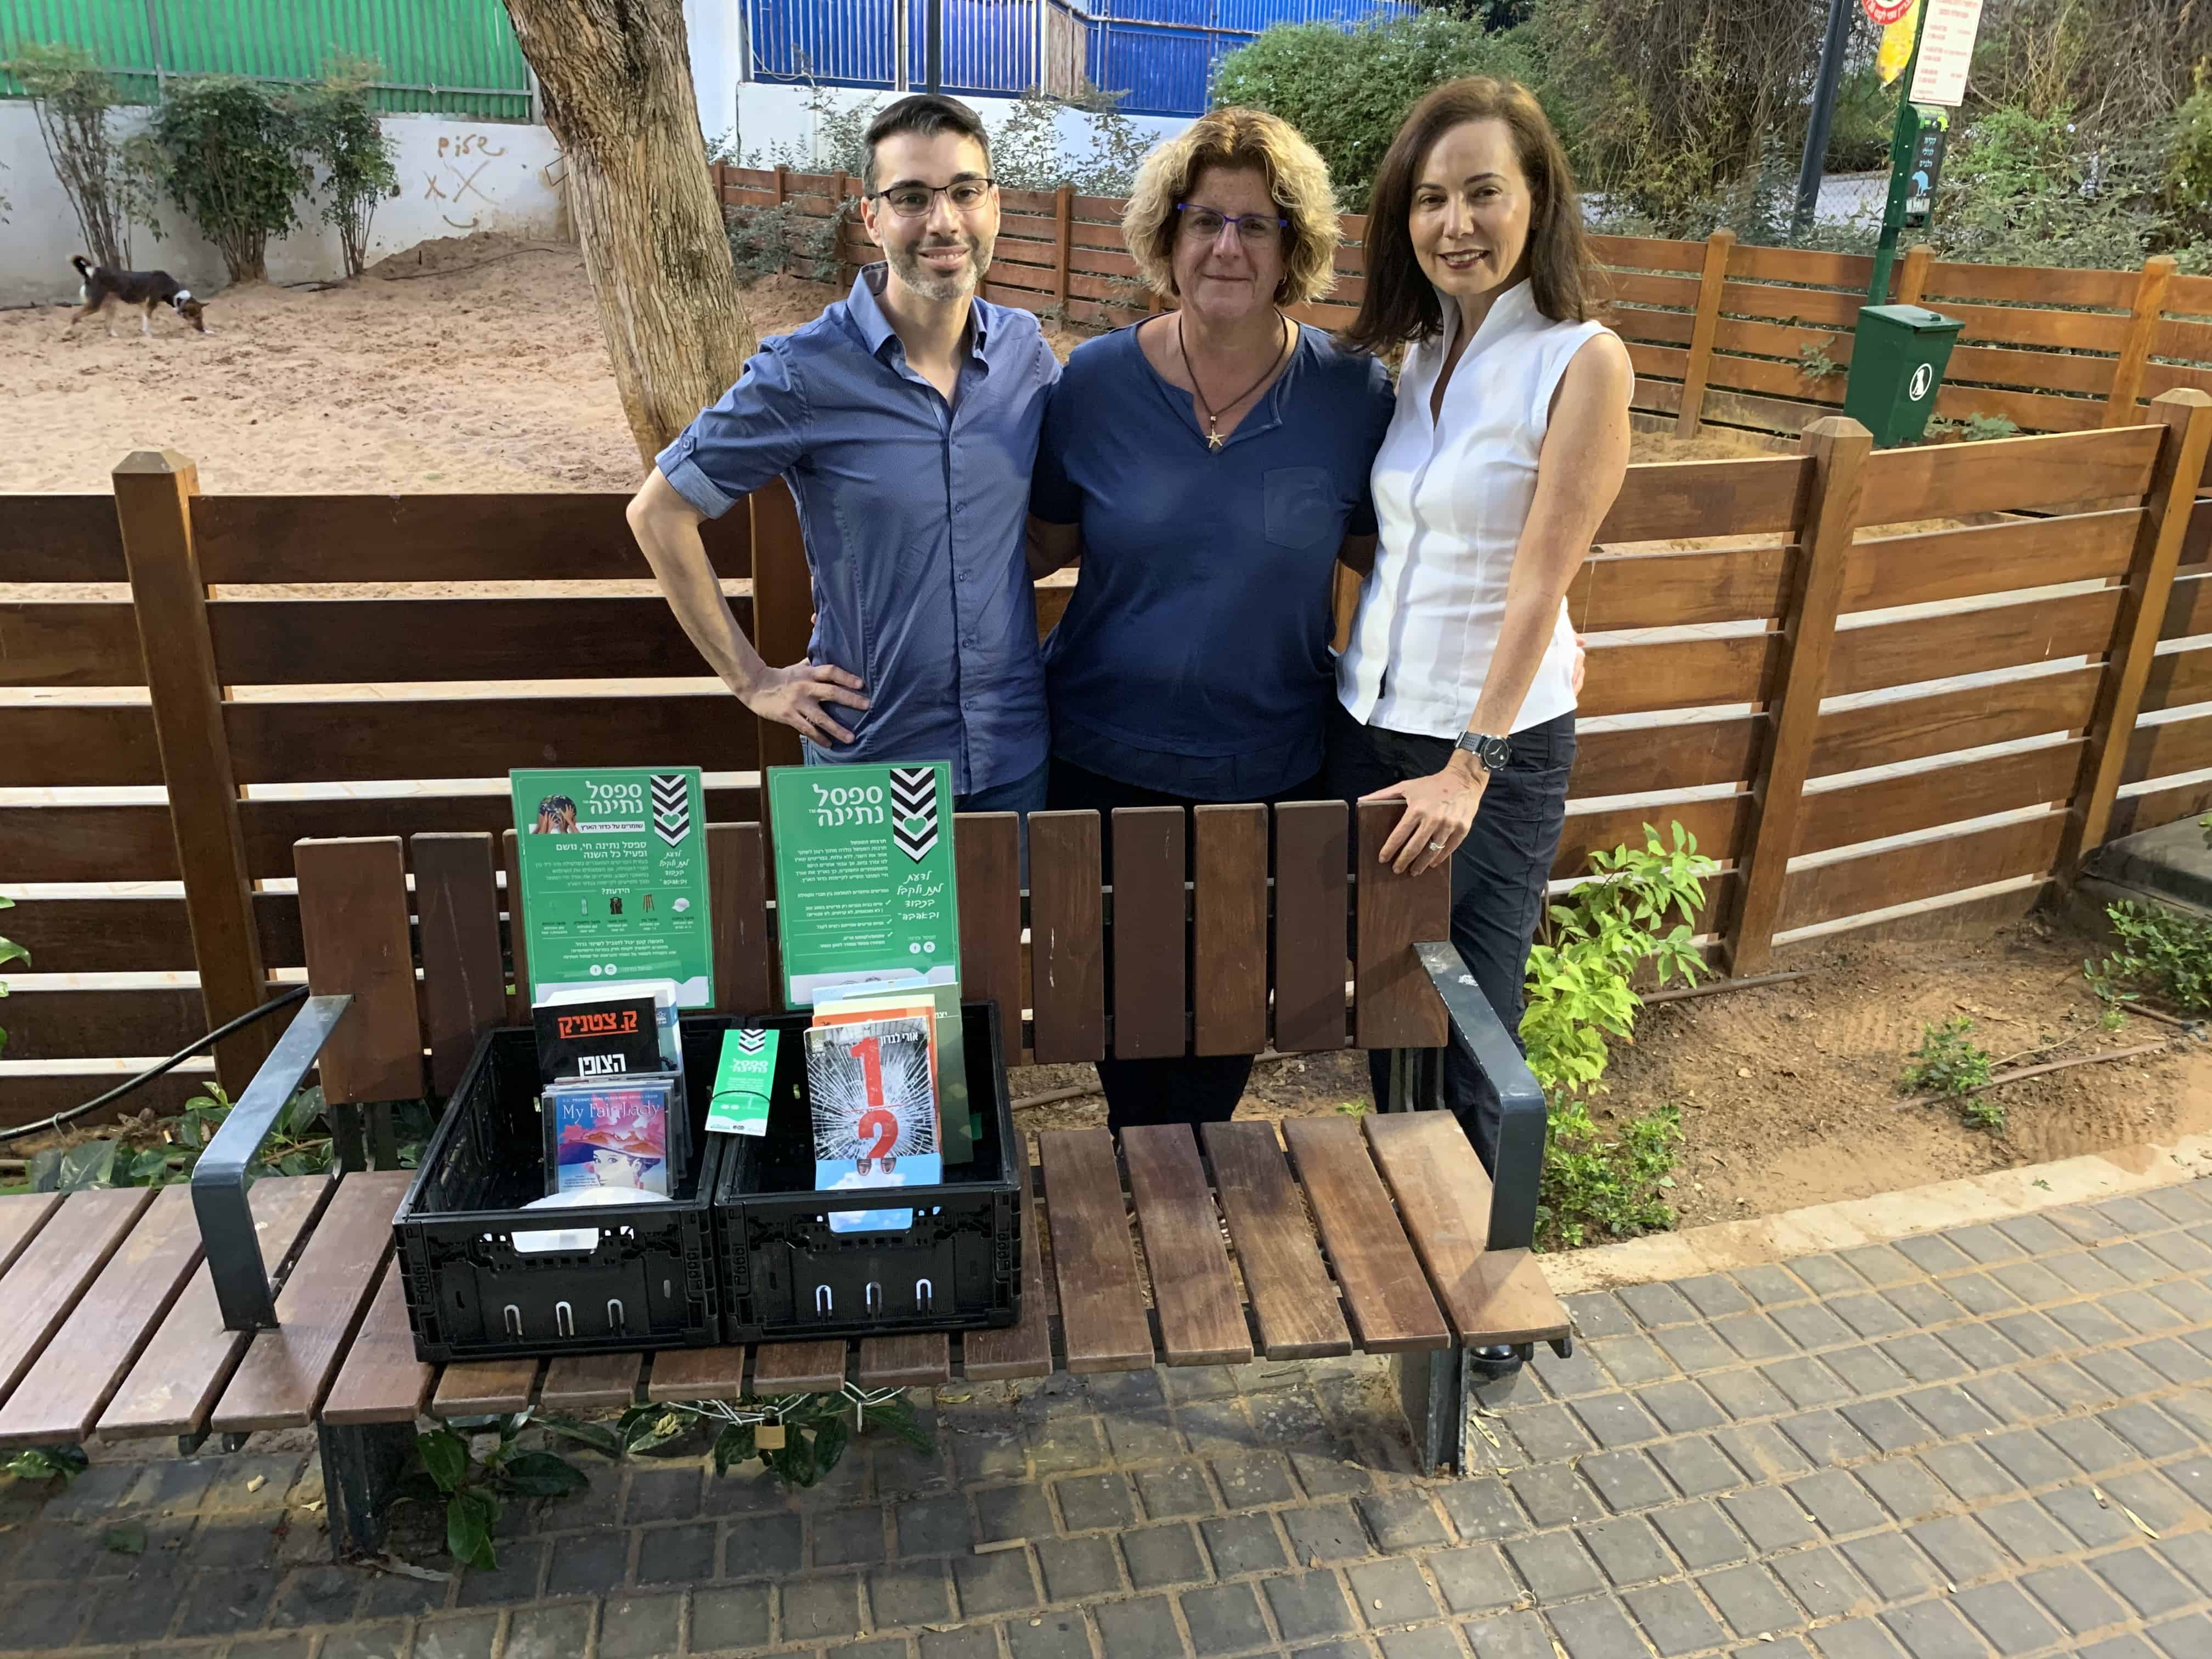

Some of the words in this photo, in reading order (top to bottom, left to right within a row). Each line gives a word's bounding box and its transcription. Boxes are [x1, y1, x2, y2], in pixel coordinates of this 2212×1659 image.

[585, 781, 642, 799] ספסל
[812, 783, 883, 807] ספסל
[588, 799, 644, 815] נתינה
[816, 806, 884, 827] נתינה
[556, 843, 577, 851] נושם
[584, 850, 607, 859] השנה
[903, 871, 932, 884] לדעת
[897, 884, 922, 898] ולקבל
[922, 883, 944, 896] לתת
[905, 899, 935, 909] בכבוד
[902, 912, 939, 921] ובאהבה
[557, 1013, 617, 1037] צטניק
[621, 1011, 637, 1031] ק.
[880, 1032, 900, 1046] לברון
[902, 1031, 918, 1042] אורי
[578, 1053, 627, 1079] הצופן
[733, 1058, 768, 1068] ספסל
[851, 1036, 884, 1107] 1
[562, 1104, 584, 1124] My
[590, 1102, 619, 1118] Fair
[623, 1101, 660, 1120] Lady
[858, 1109, 899, 1159] 2
